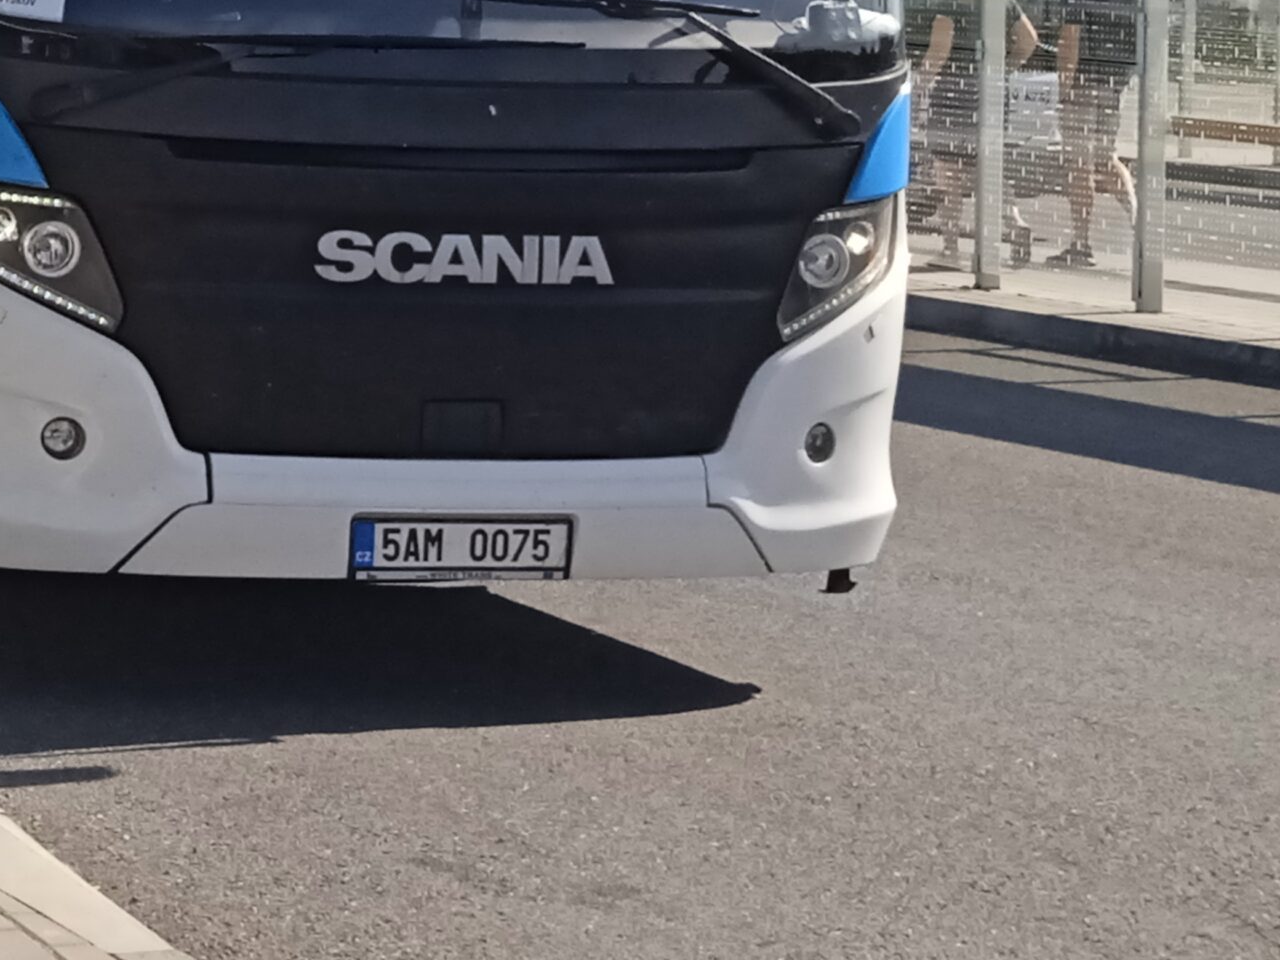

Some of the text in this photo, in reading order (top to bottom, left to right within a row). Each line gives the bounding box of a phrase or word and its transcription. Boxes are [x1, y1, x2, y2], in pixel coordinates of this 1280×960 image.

[314, 229, 615, 285] SCANIA
[355, 551, 373, 562] CZ
[382, 527, 552, 563] 5AM 0075
